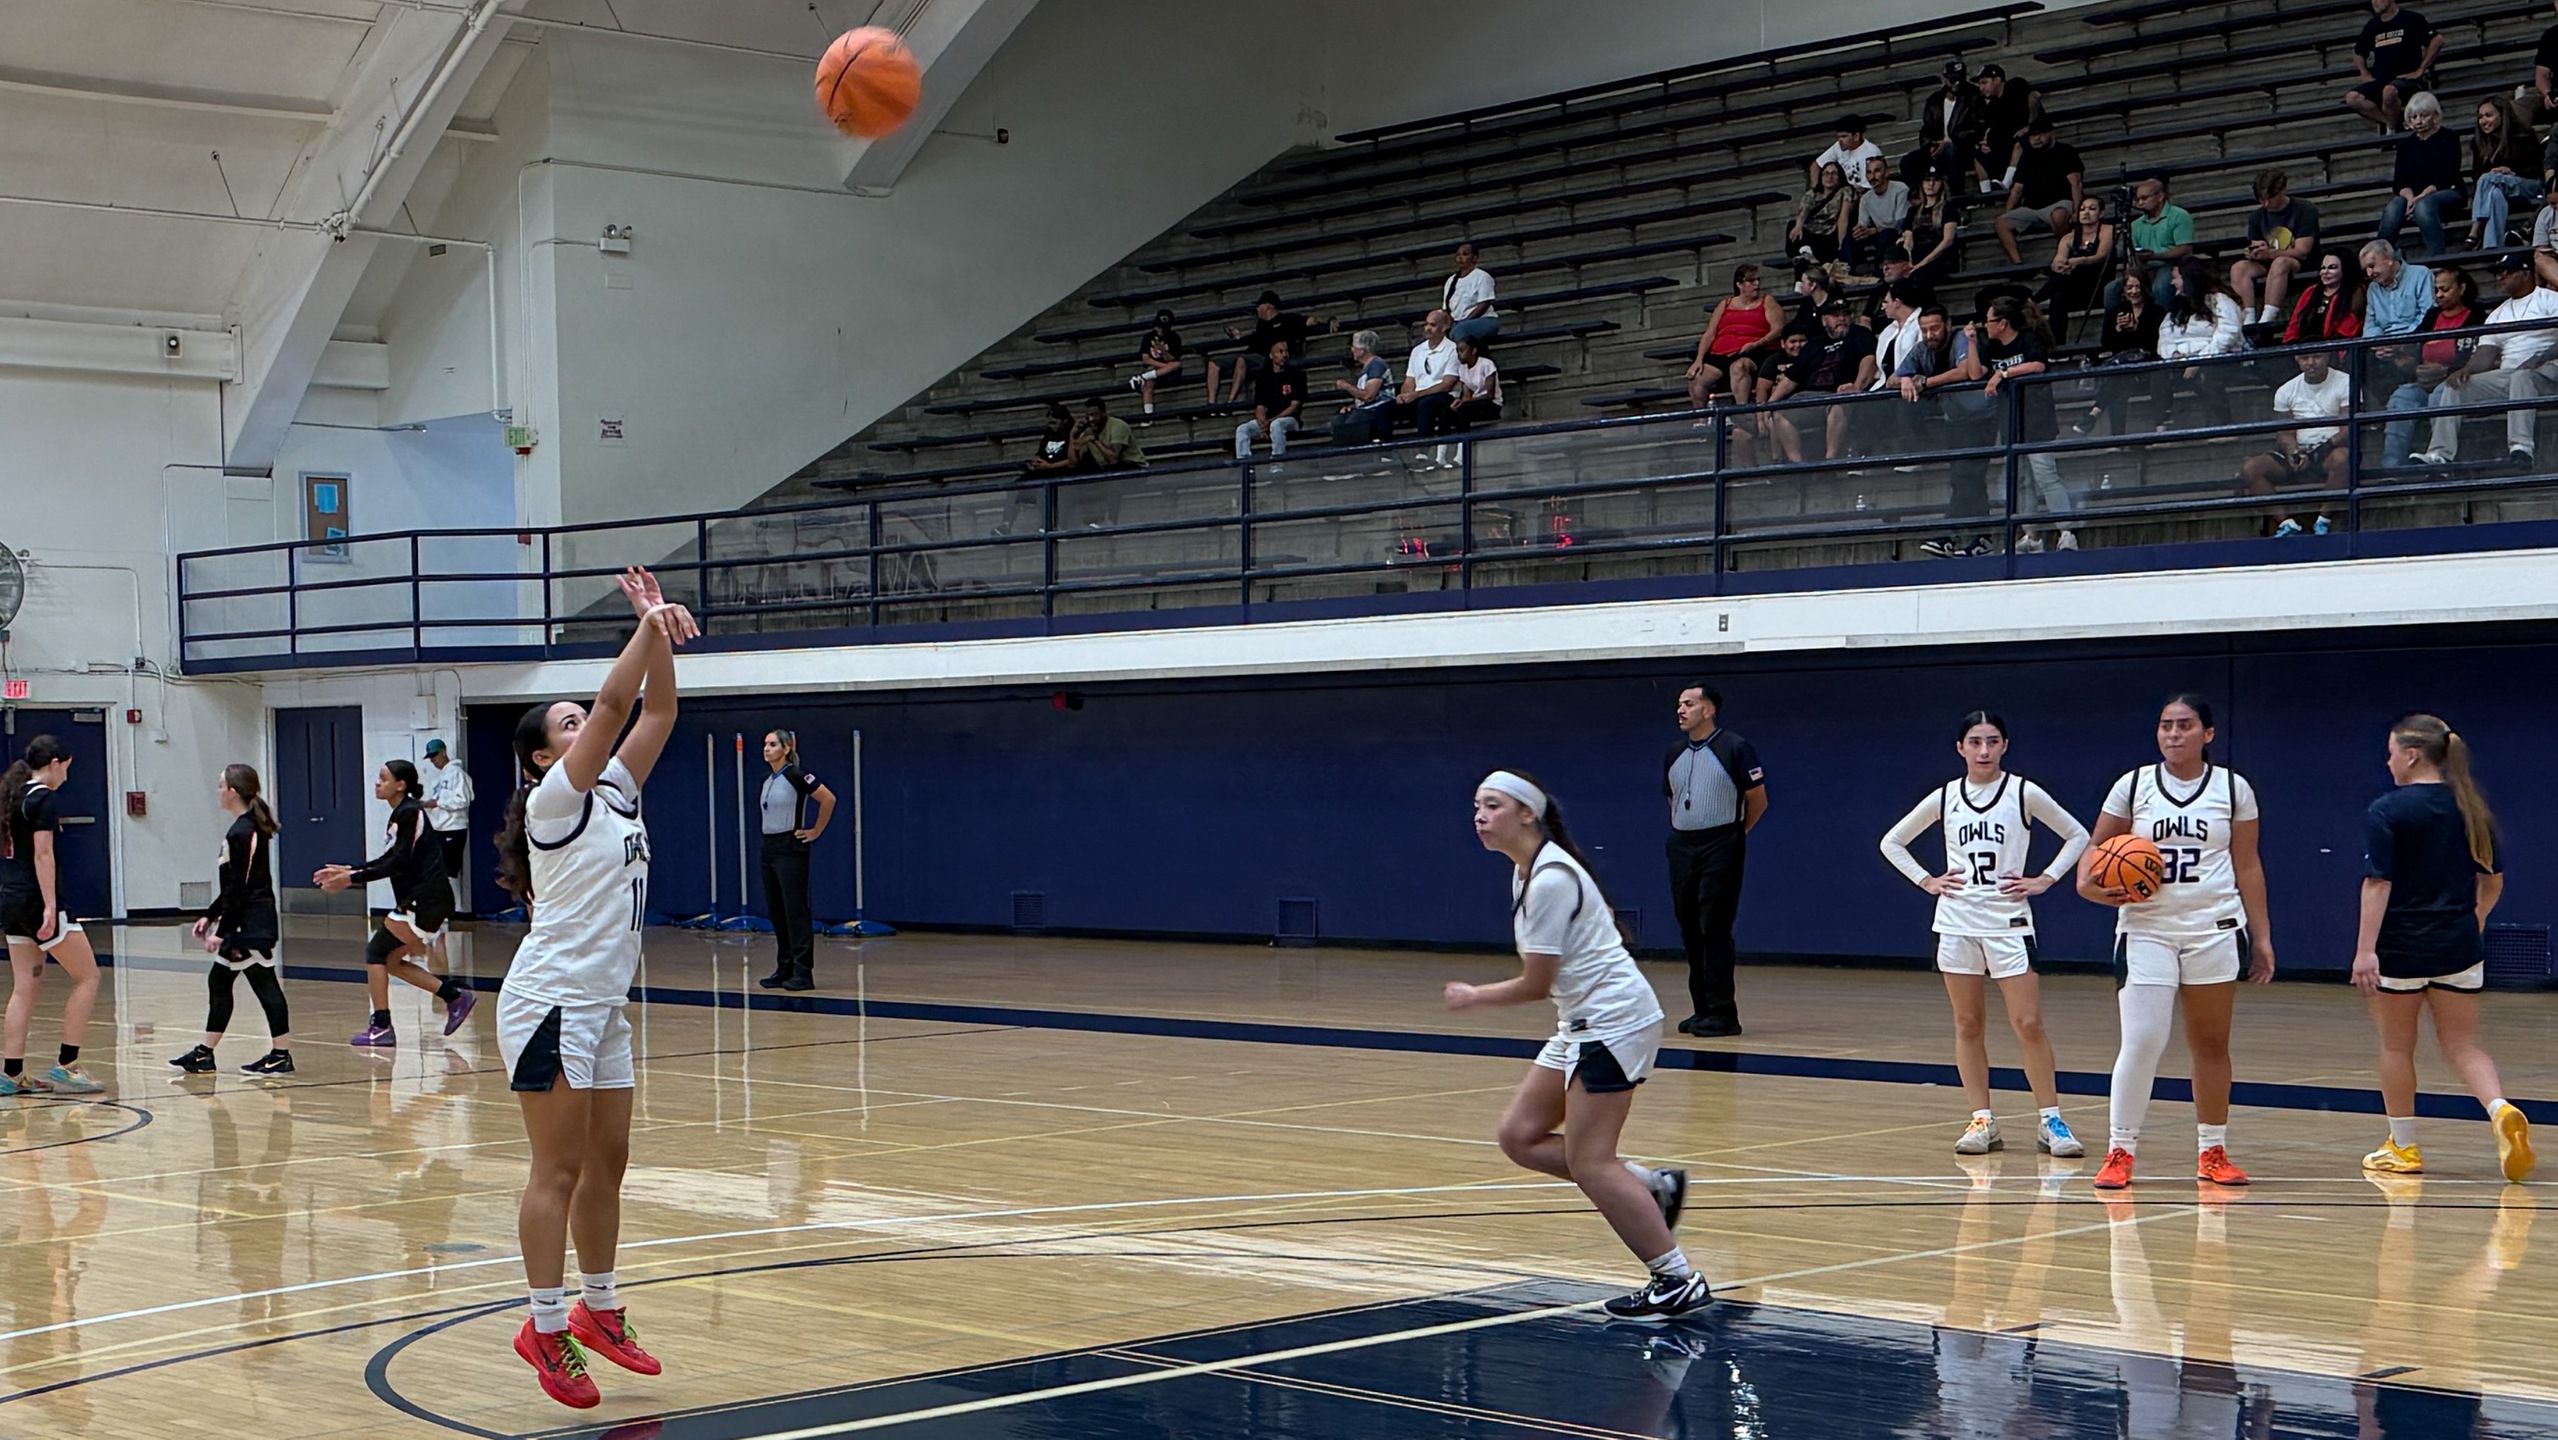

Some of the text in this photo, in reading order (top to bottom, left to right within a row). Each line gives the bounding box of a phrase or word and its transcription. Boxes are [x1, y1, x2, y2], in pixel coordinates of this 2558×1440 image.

[1959, 821, 2005, 847] OWLS
[2153, 816, 2208, 842] OWLS
[1968, 852, 1996, 885] 12
[2159, 848, 2201, 884] 32
[630, 877, 643, 932] 11
